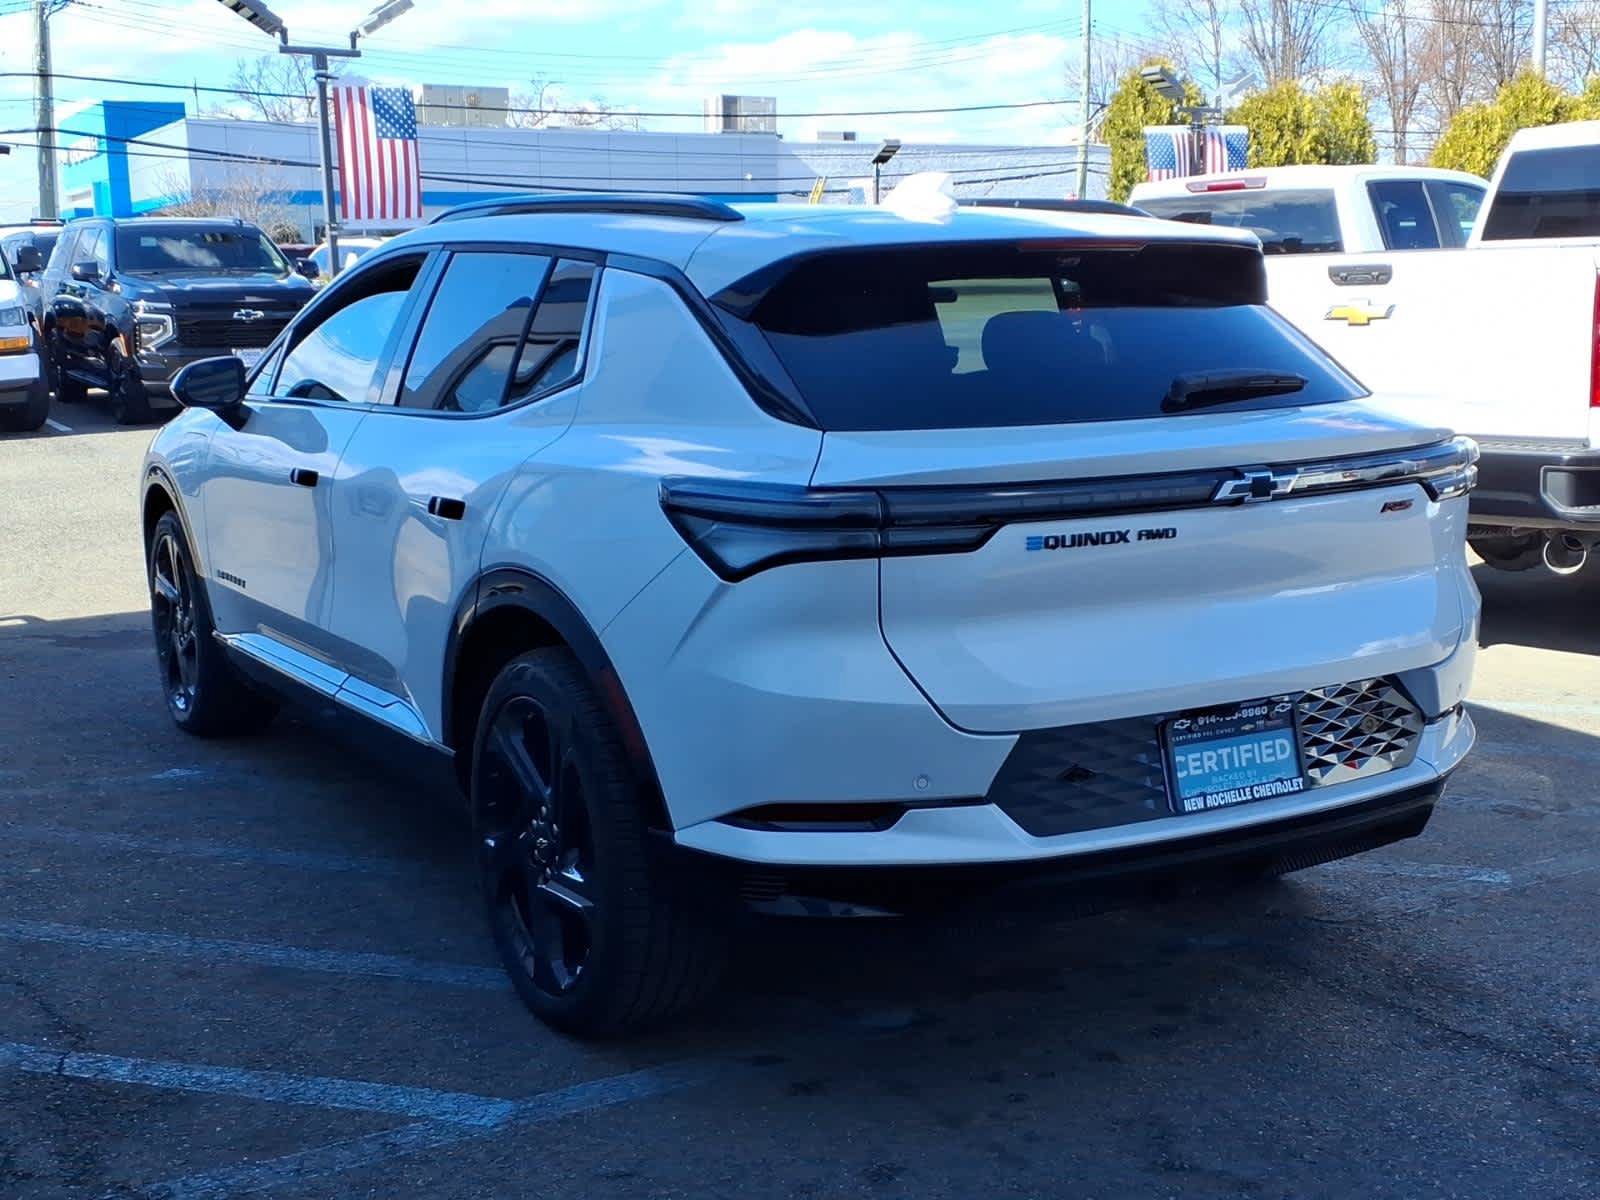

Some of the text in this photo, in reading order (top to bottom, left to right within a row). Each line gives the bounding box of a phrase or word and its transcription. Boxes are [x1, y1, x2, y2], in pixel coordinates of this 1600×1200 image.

[1026, 527, 1178, 551] EQUINOX AWD
[1176, 738, 1290, 778] CERTIFIED
[1184, 795, 1205, 812] NEW
[1206, 786, 1253, 808] ROCHELLE
[1253, 777, 1304, 799] CHEVROLET
